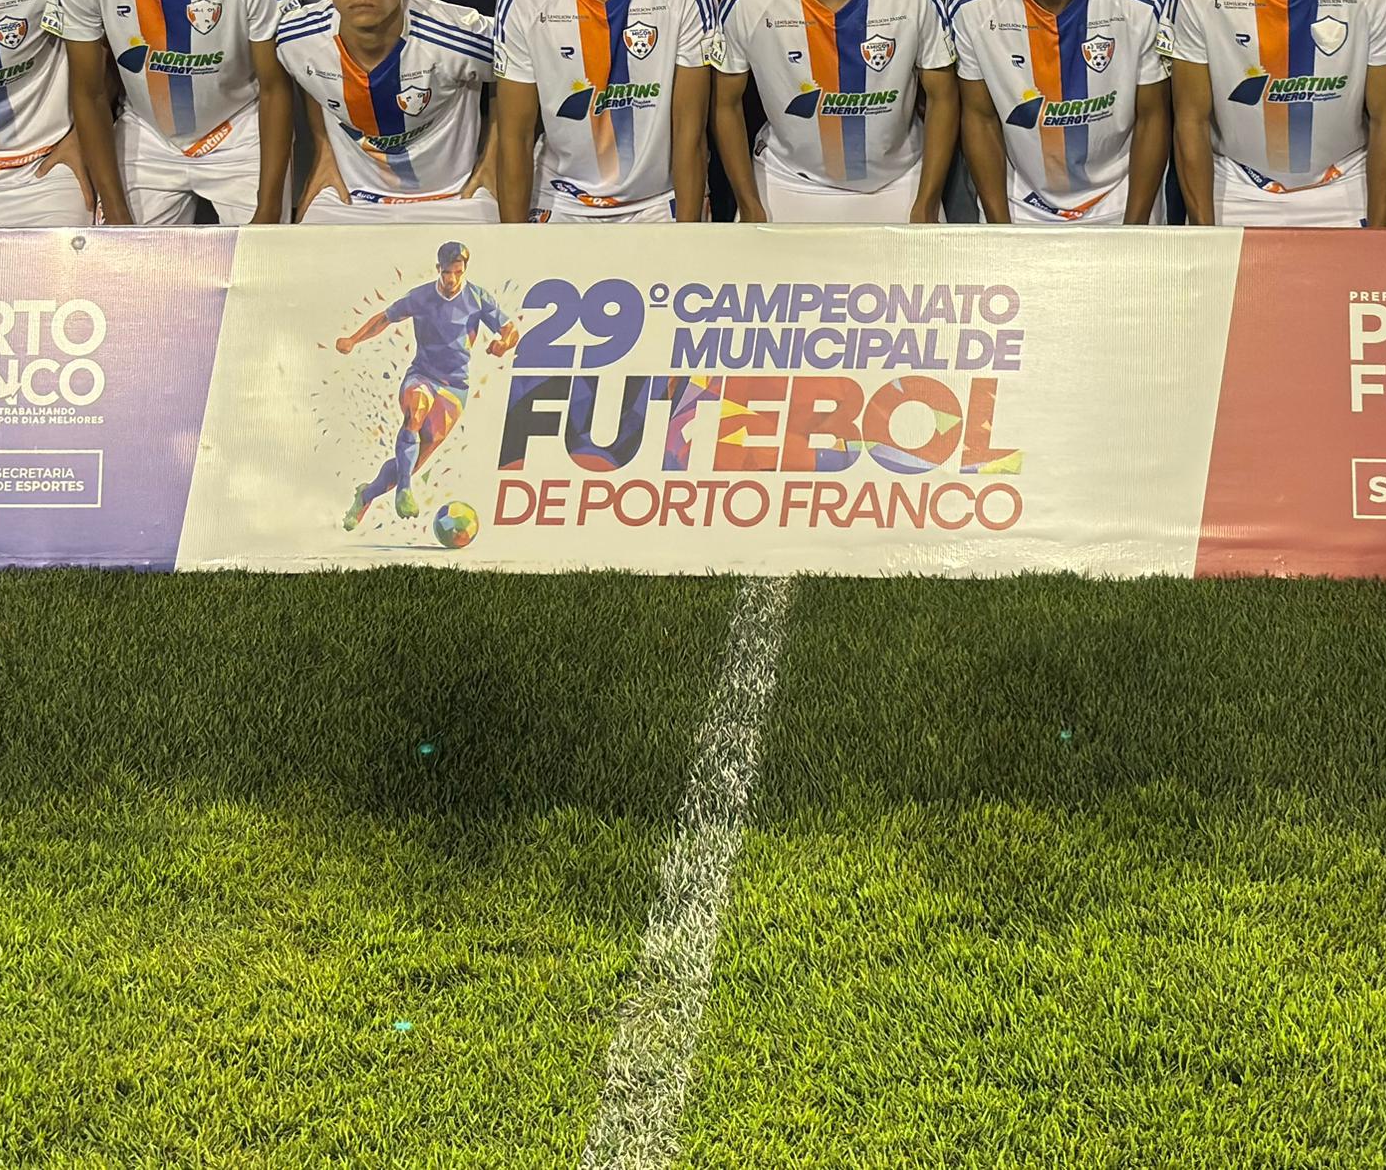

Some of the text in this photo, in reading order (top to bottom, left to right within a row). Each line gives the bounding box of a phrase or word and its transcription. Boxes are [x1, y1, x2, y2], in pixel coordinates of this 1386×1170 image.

[150, 50, 225, 66] NORTINS
[1270, 75, 1348, 92] NORTINS
[822, 90, 899, 107] NORTINS
[1044, 90, 1117, 116] NORTINS
[672, 283, 1021, 325] CAMPEONATO
[670, 327, 1025, 371] MUNICIPAL DE
[22, 416, 46, 424] DIAS
[49, 415, 104, 424] MELHORES
[497, 375, 1025, 475] FUTEBOL
[16, 481, 85, 492] ESPORTES
[493, 479, 1023, 529] DE PORTO FRANCO
